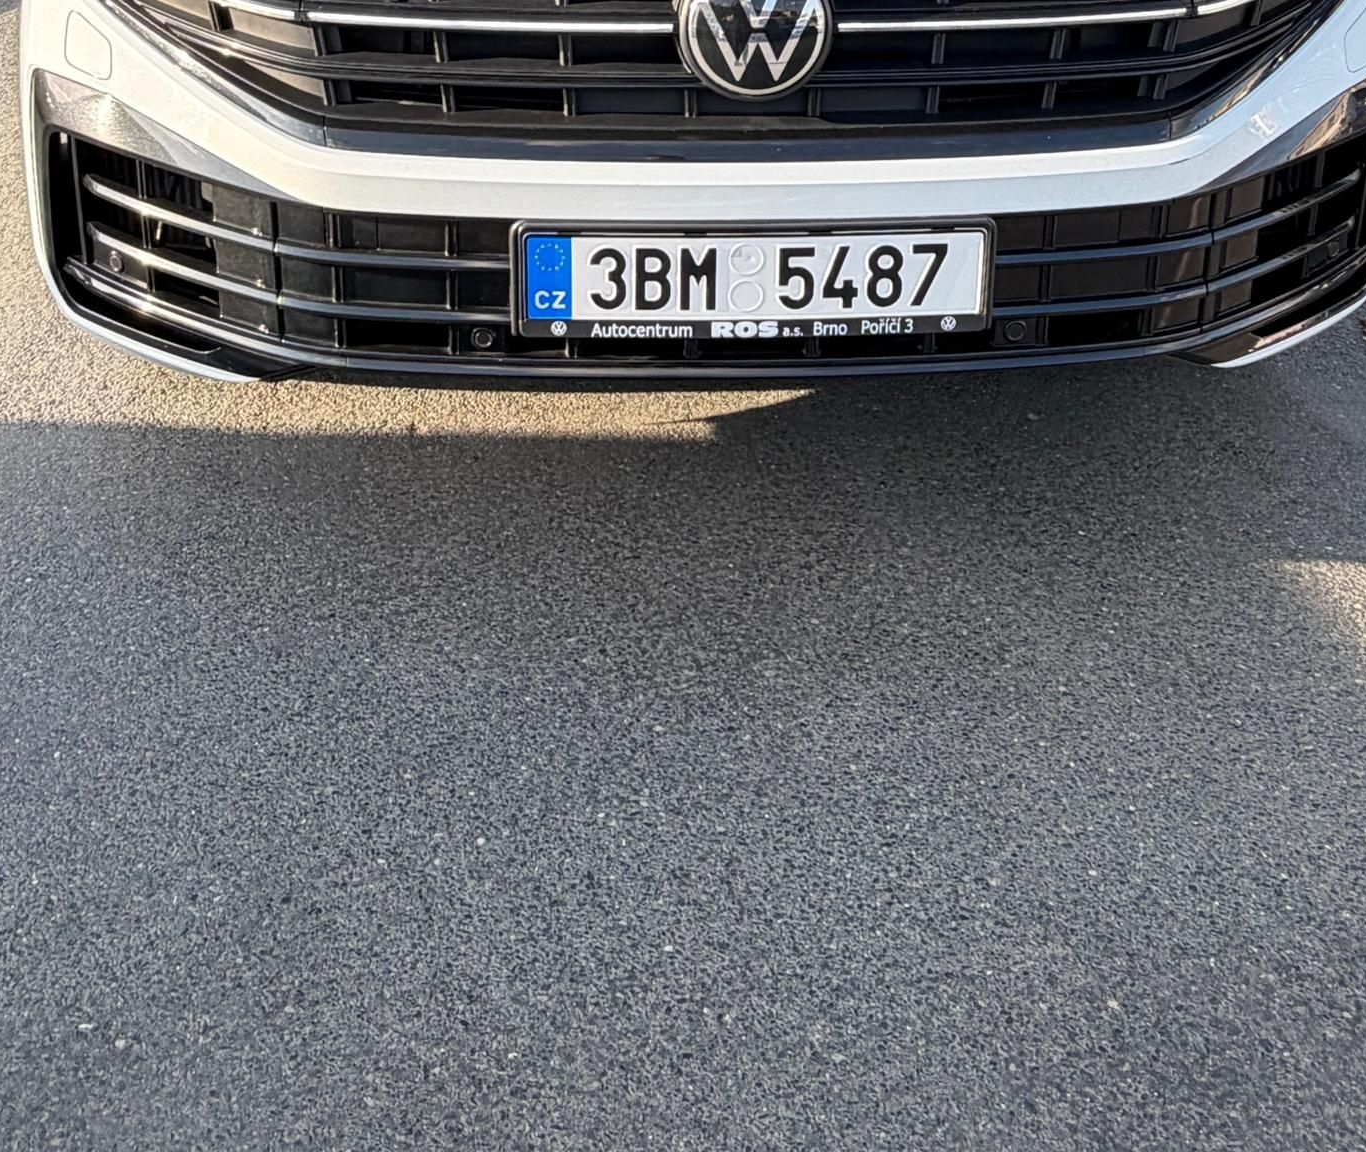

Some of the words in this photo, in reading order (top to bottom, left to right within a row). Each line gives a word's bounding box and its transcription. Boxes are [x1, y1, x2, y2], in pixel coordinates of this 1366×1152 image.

[589, 247, 717, 311] 3BM
[777, 244, 948, 310] 5487
[535, 291, 566, 310] CZ
[591, 323, 693, 338] Autocentrum
[711, 321, 779, 338] ROS
[782, 327, 804, 337] a.s.
[813, 321, 847, 336] Brno
[861, 318, 901, 335] Poříčí
[904, 318, 914, 334] 3
